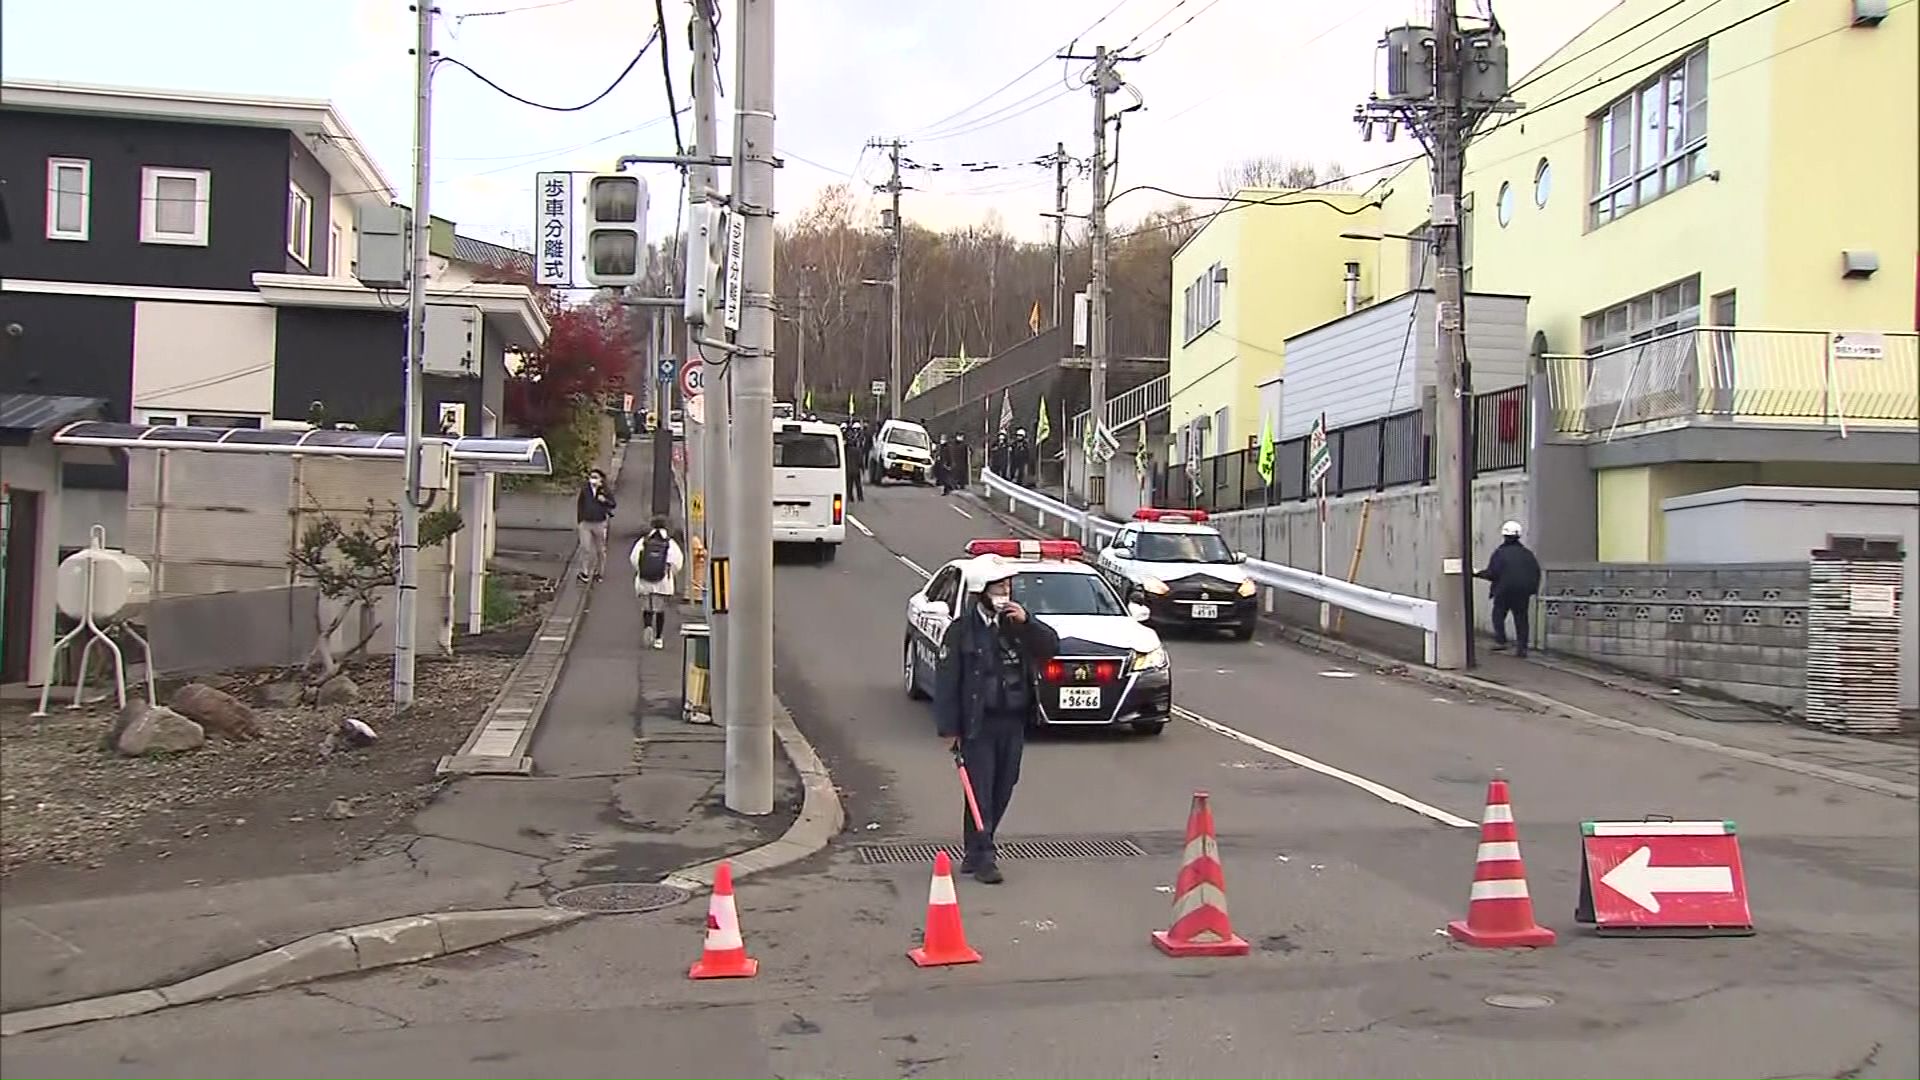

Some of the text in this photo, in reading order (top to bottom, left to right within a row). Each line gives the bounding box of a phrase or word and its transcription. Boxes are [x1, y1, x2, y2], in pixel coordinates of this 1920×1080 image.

[544, 179, 564, 278] 歩車分離式
